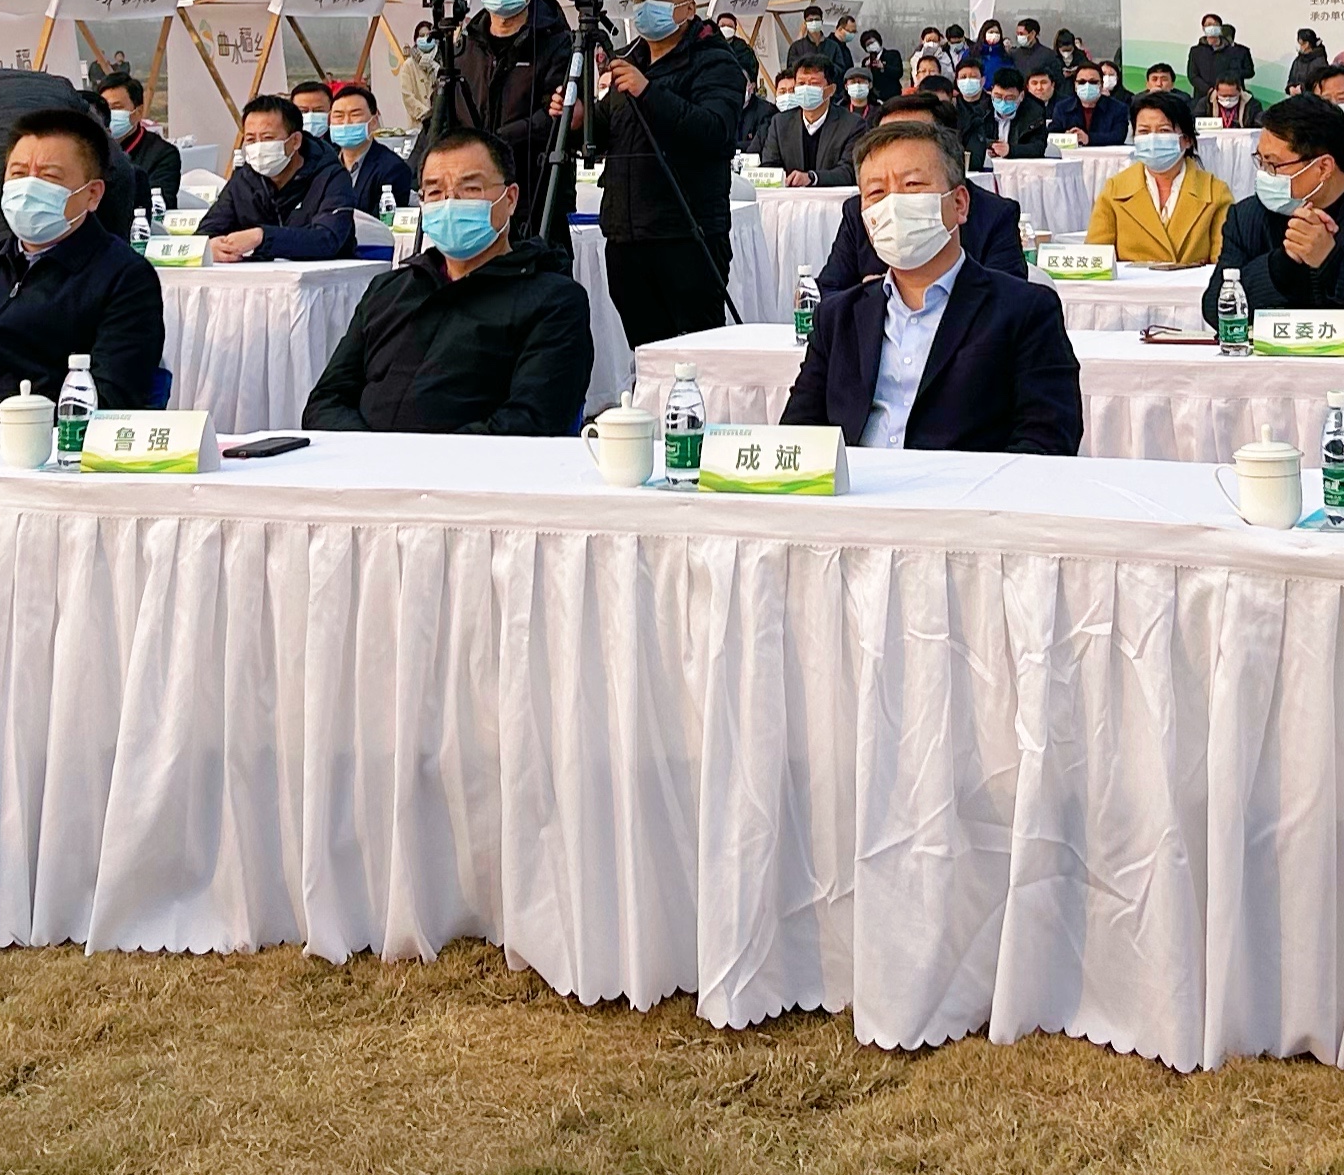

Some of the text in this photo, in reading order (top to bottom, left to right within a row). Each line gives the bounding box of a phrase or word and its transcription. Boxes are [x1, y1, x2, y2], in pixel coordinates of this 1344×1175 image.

[1047, 255, 1103, 269] 区发改委
[1273, 321, 1338, 340] 区委办
[113, 426, 171, 452] 鲁强
[735, 443, 802, 472] 成斌
